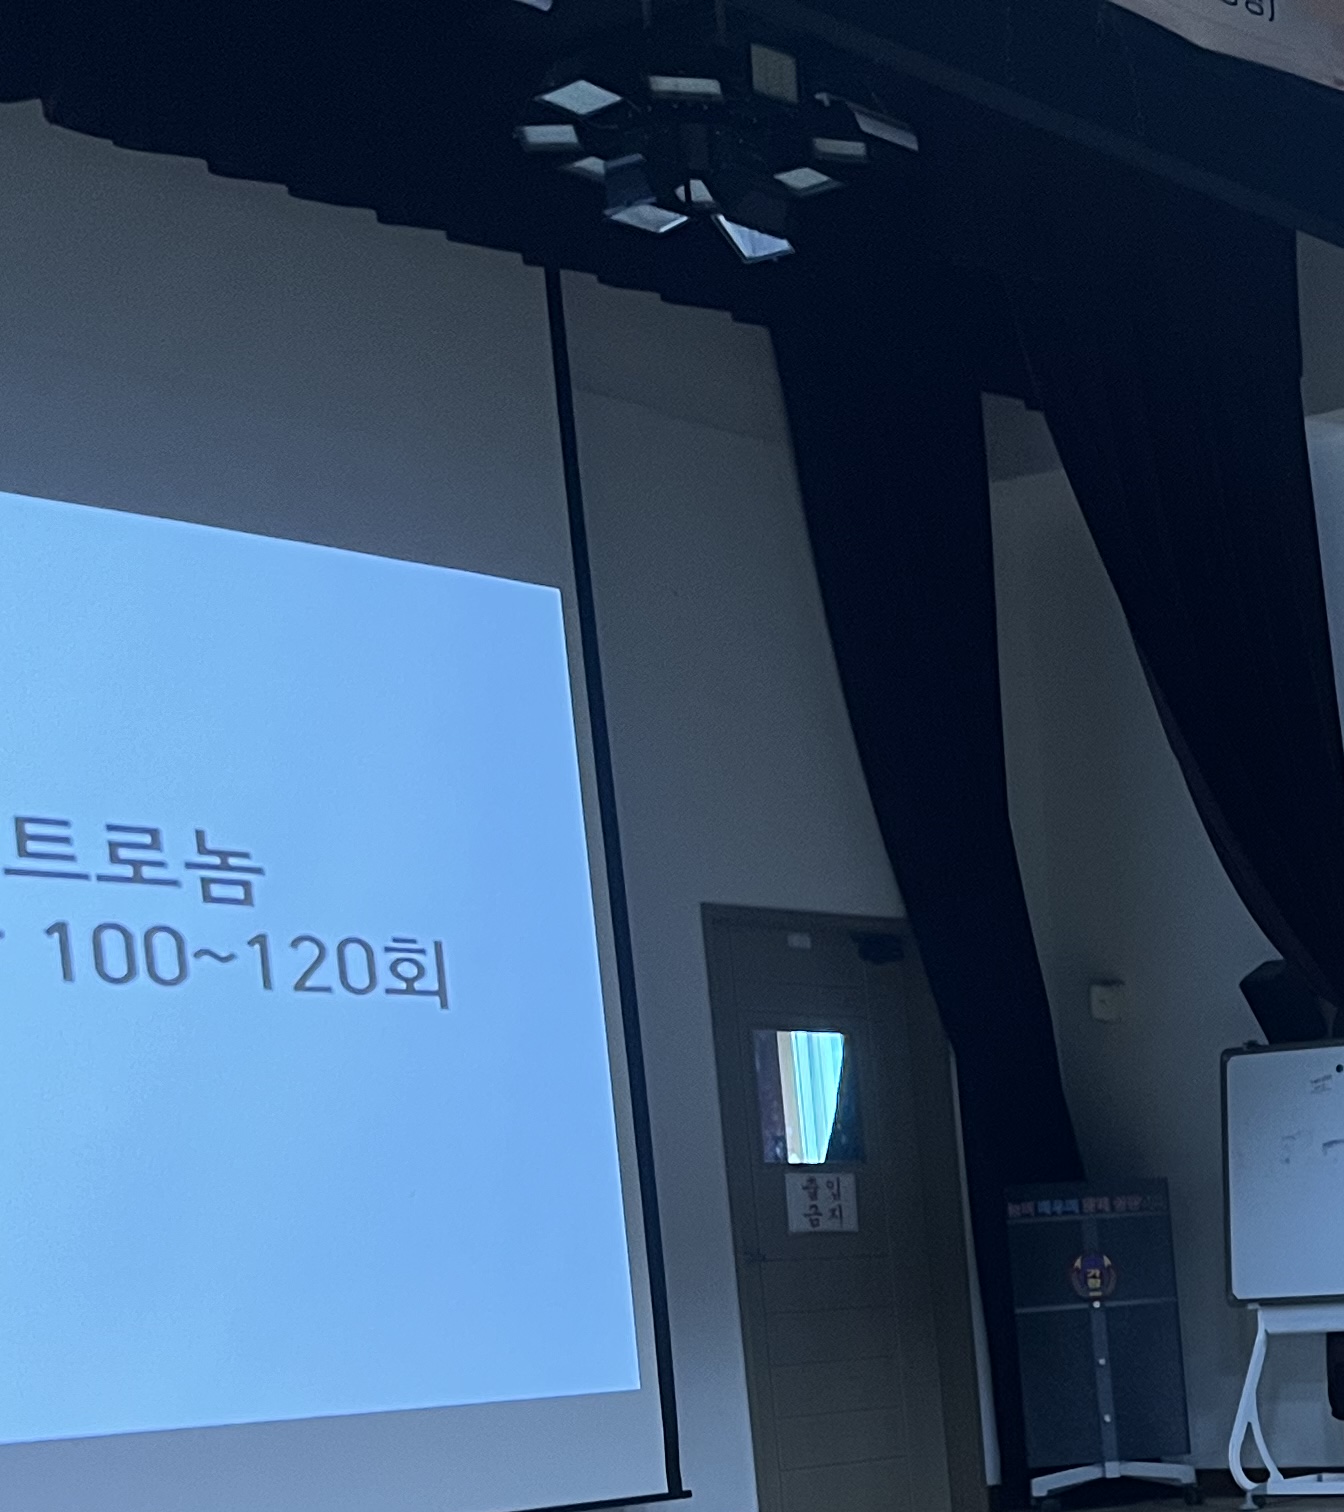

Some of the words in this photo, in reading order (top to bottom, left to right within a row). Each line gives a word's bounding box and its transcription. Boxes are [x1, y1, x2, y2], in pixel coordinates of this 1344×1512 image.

[44, 920, 450, 1010] 100~120회
[801, 1175, 841, 1202] 출입
[802, 1203, 843, 1229] 금지
